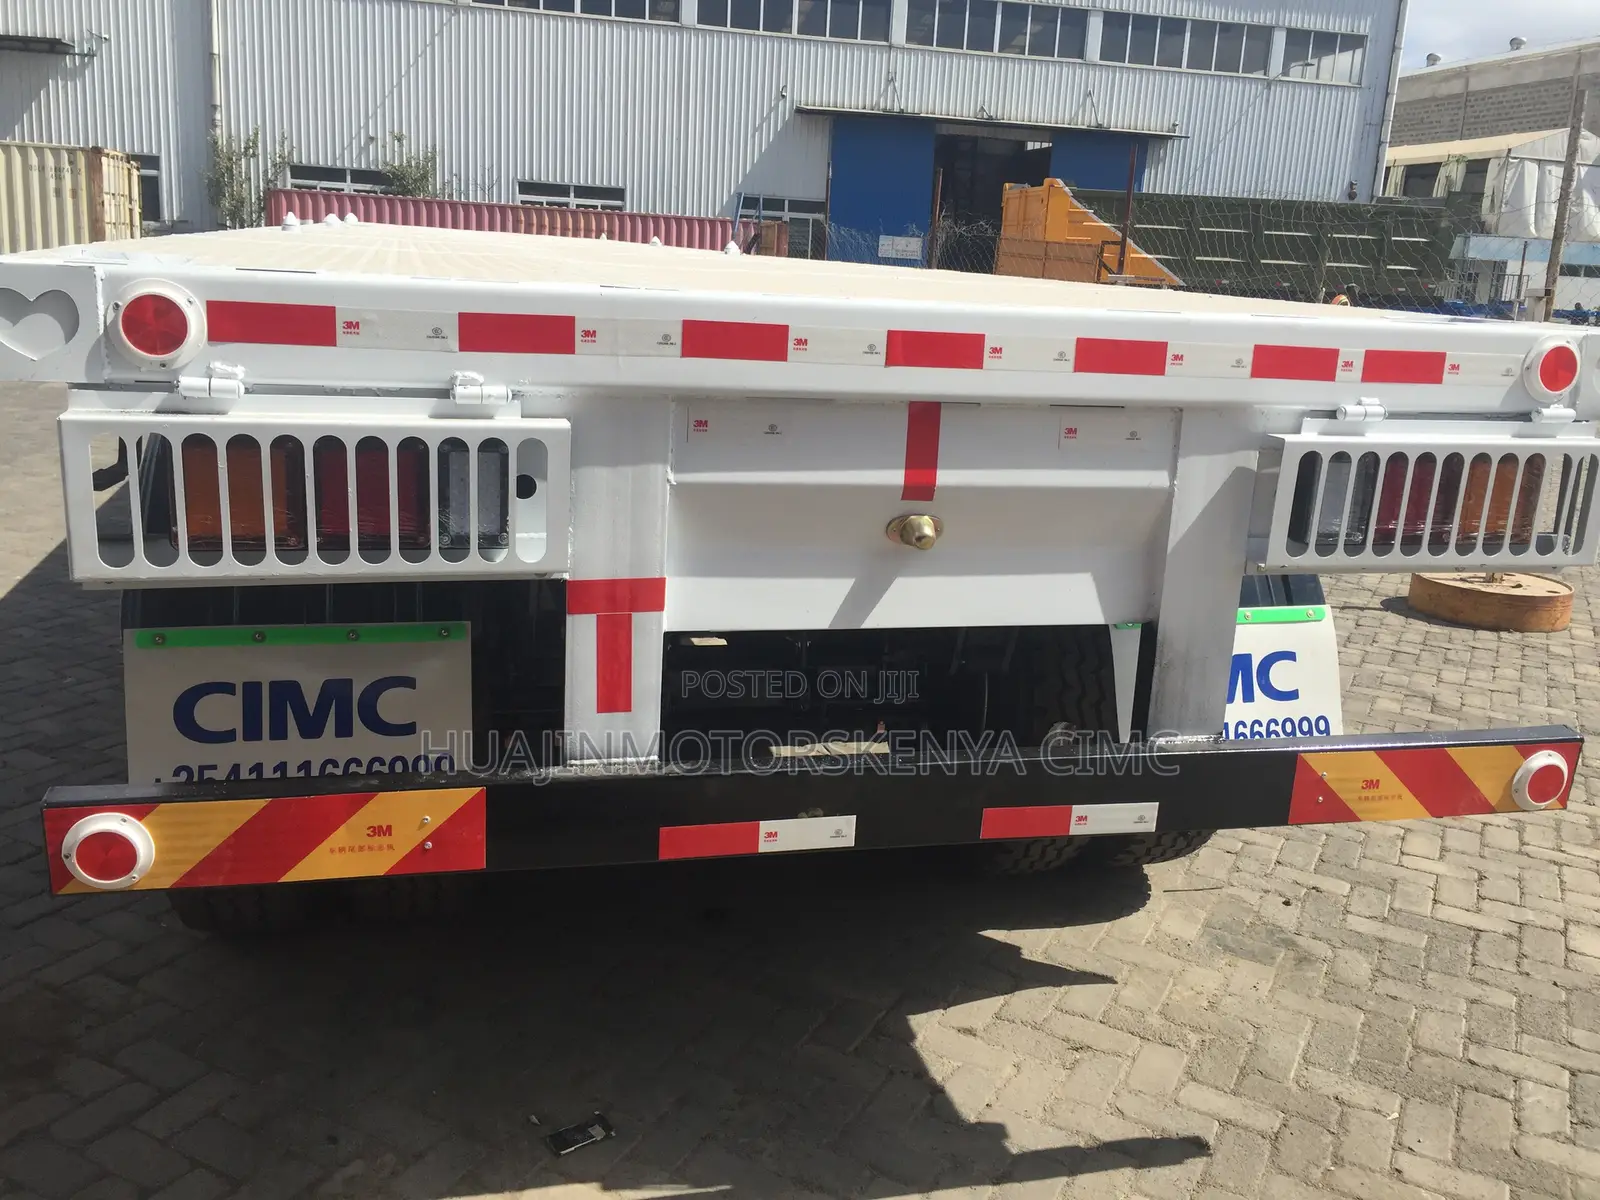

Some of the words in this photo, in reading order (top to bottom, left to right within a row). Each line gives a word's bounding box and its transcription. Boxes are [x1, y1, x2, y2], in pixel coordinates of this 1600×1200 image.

[342, 321, 360, 330] 3M
[581, 329, 597, 338] 3M
[793, 338, 808, 346] 3M
[989, 347, 1003, 355] 3M
[1171, 354, 1184, 362] 3M
[1341, 360, 1354, 369] 3M
[1448, 364, 1460, 372] 3M
[693, 420, 708, 428] 3M
[1064, 427, 1077, 435] 3M
[172, 675, 418, 744] CIMC
[1361, 779, 1380, 790] 3M
[366, 825, 393, 837] 3M
[764, 831, 778, 839] 3M
